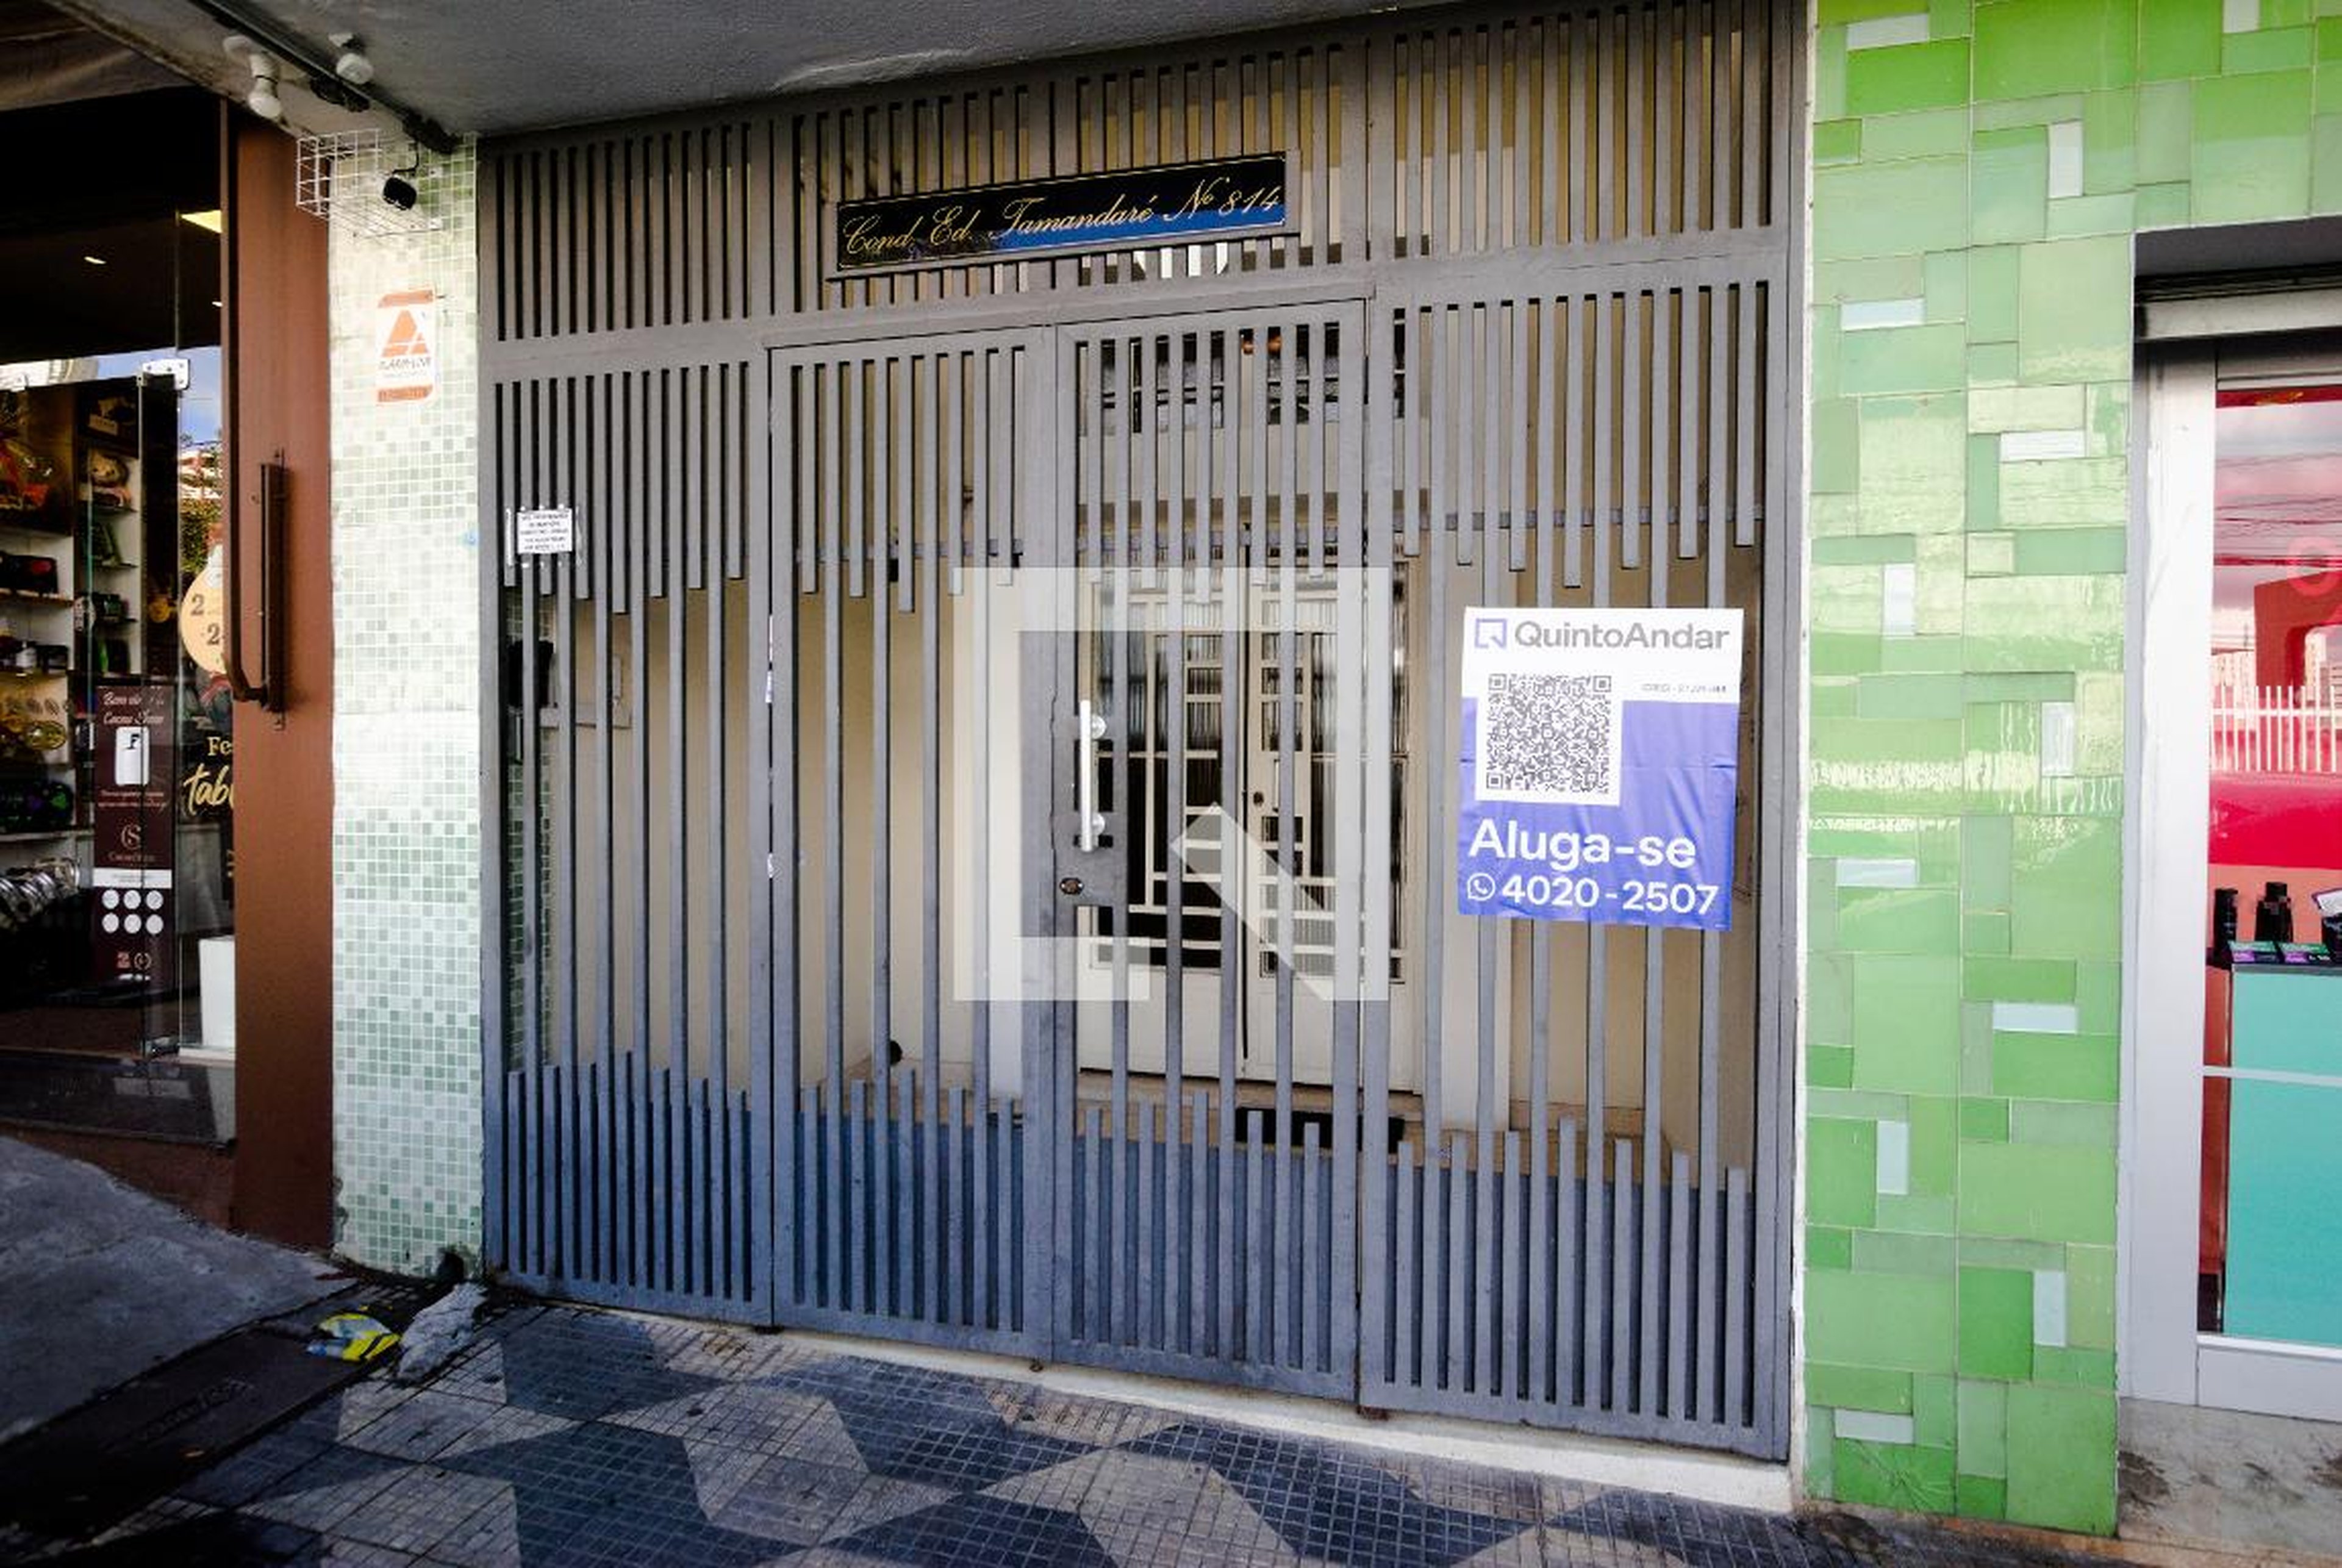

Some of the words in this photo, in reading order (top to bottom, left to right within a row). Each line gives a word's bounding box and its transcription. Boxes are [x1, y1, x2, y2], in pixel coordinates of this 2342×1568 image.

[988, 193, 1158, 239] Tamandaré
[1219, 185, 1281, 215] 814
[1514, 621, 1730, 650] QuintoAndar
[1468, 818, 1697, 872] Aluga-se
